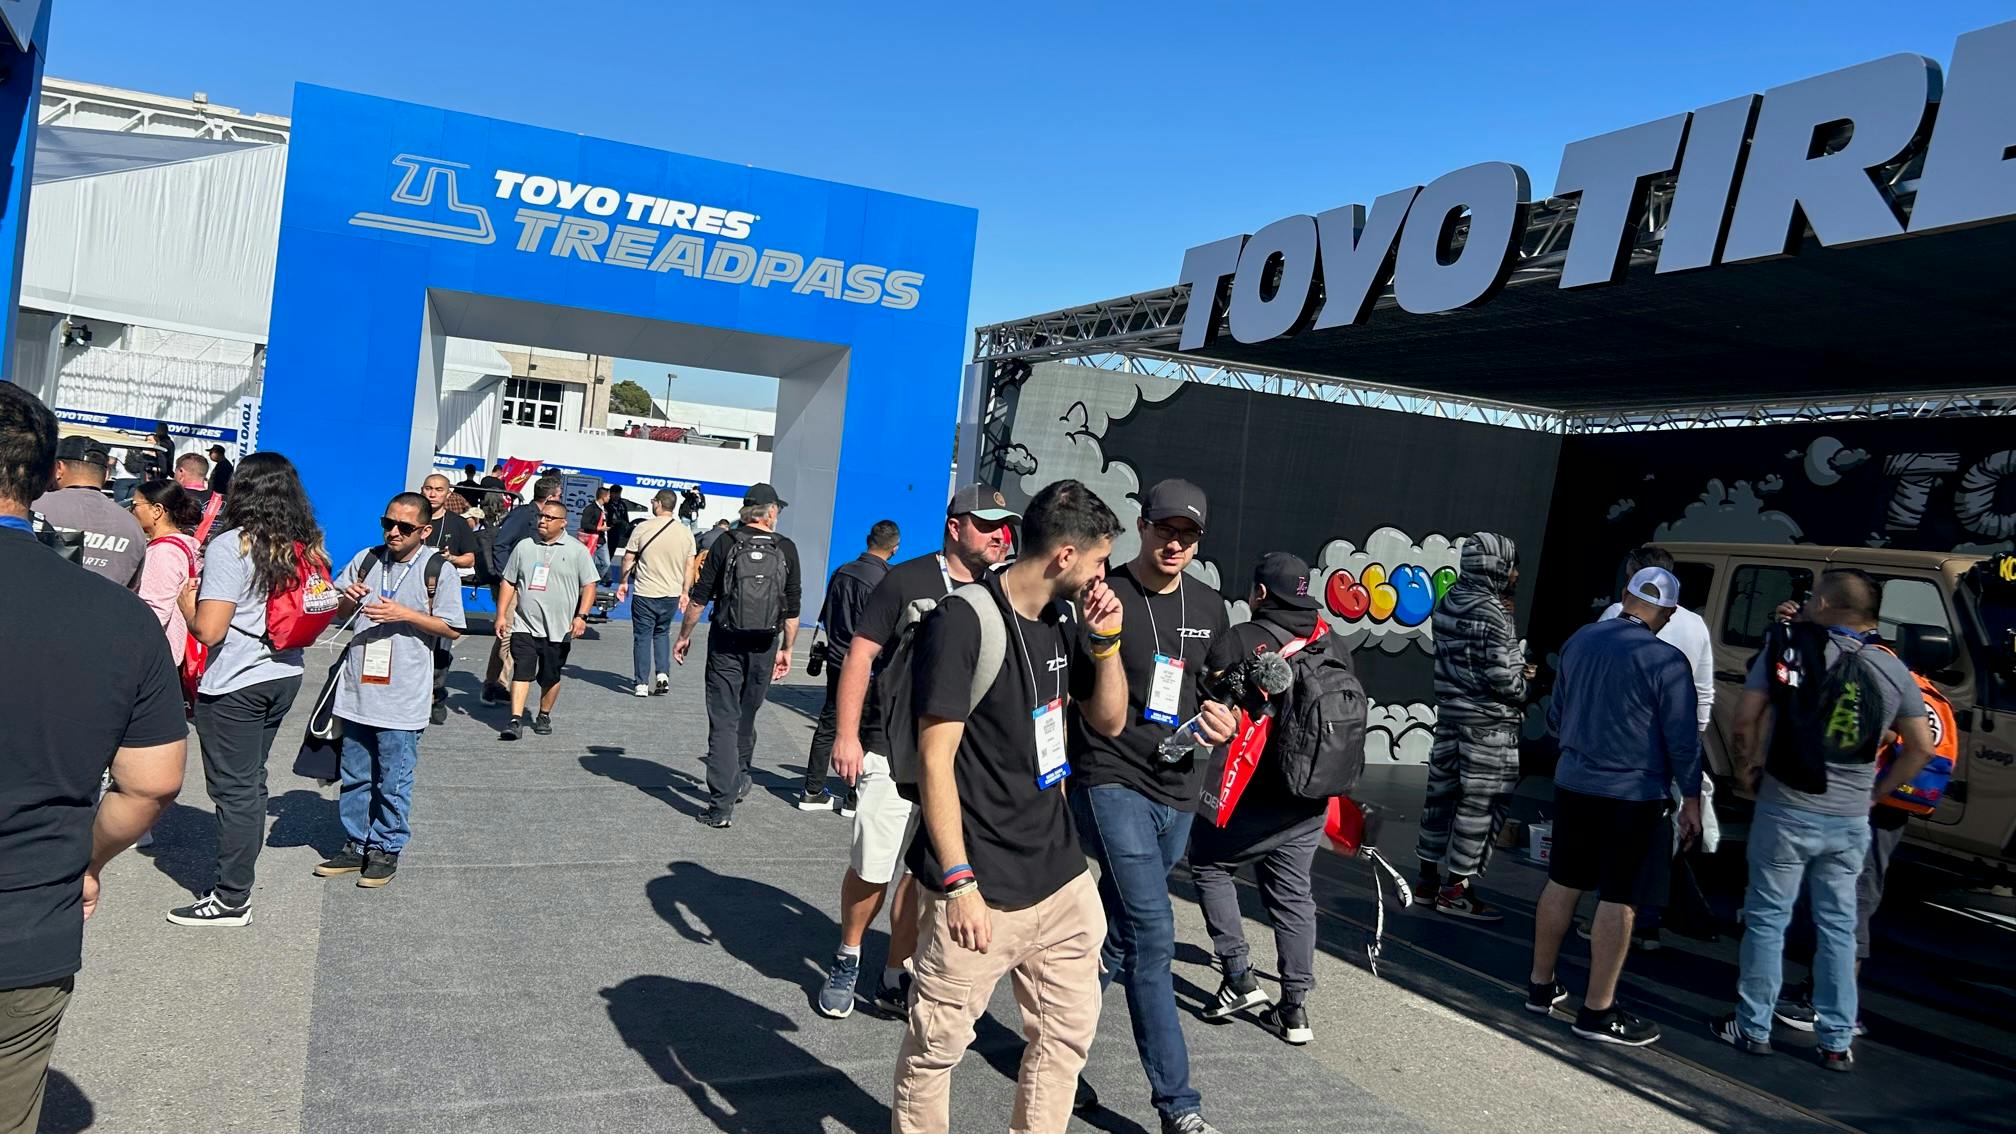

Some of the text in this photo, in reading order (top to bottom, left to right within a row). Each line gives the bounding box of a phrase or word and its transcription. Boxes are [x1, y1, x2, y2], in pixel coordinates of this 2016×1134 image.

[494, 169, 757, 240] TOYO TIRES
[513, 207, 925, 311] TREADPASS
[1179, 161, 1530, 351] TOYO
[54, 410, 110, 424] OYO TIRES
[168, 424, 224, 438] OYO TIRES
[433, 456, 458, 466] RES
[636, 477, 666, 487] TOYO
[1975, 746, 2014, 766] Jeep
